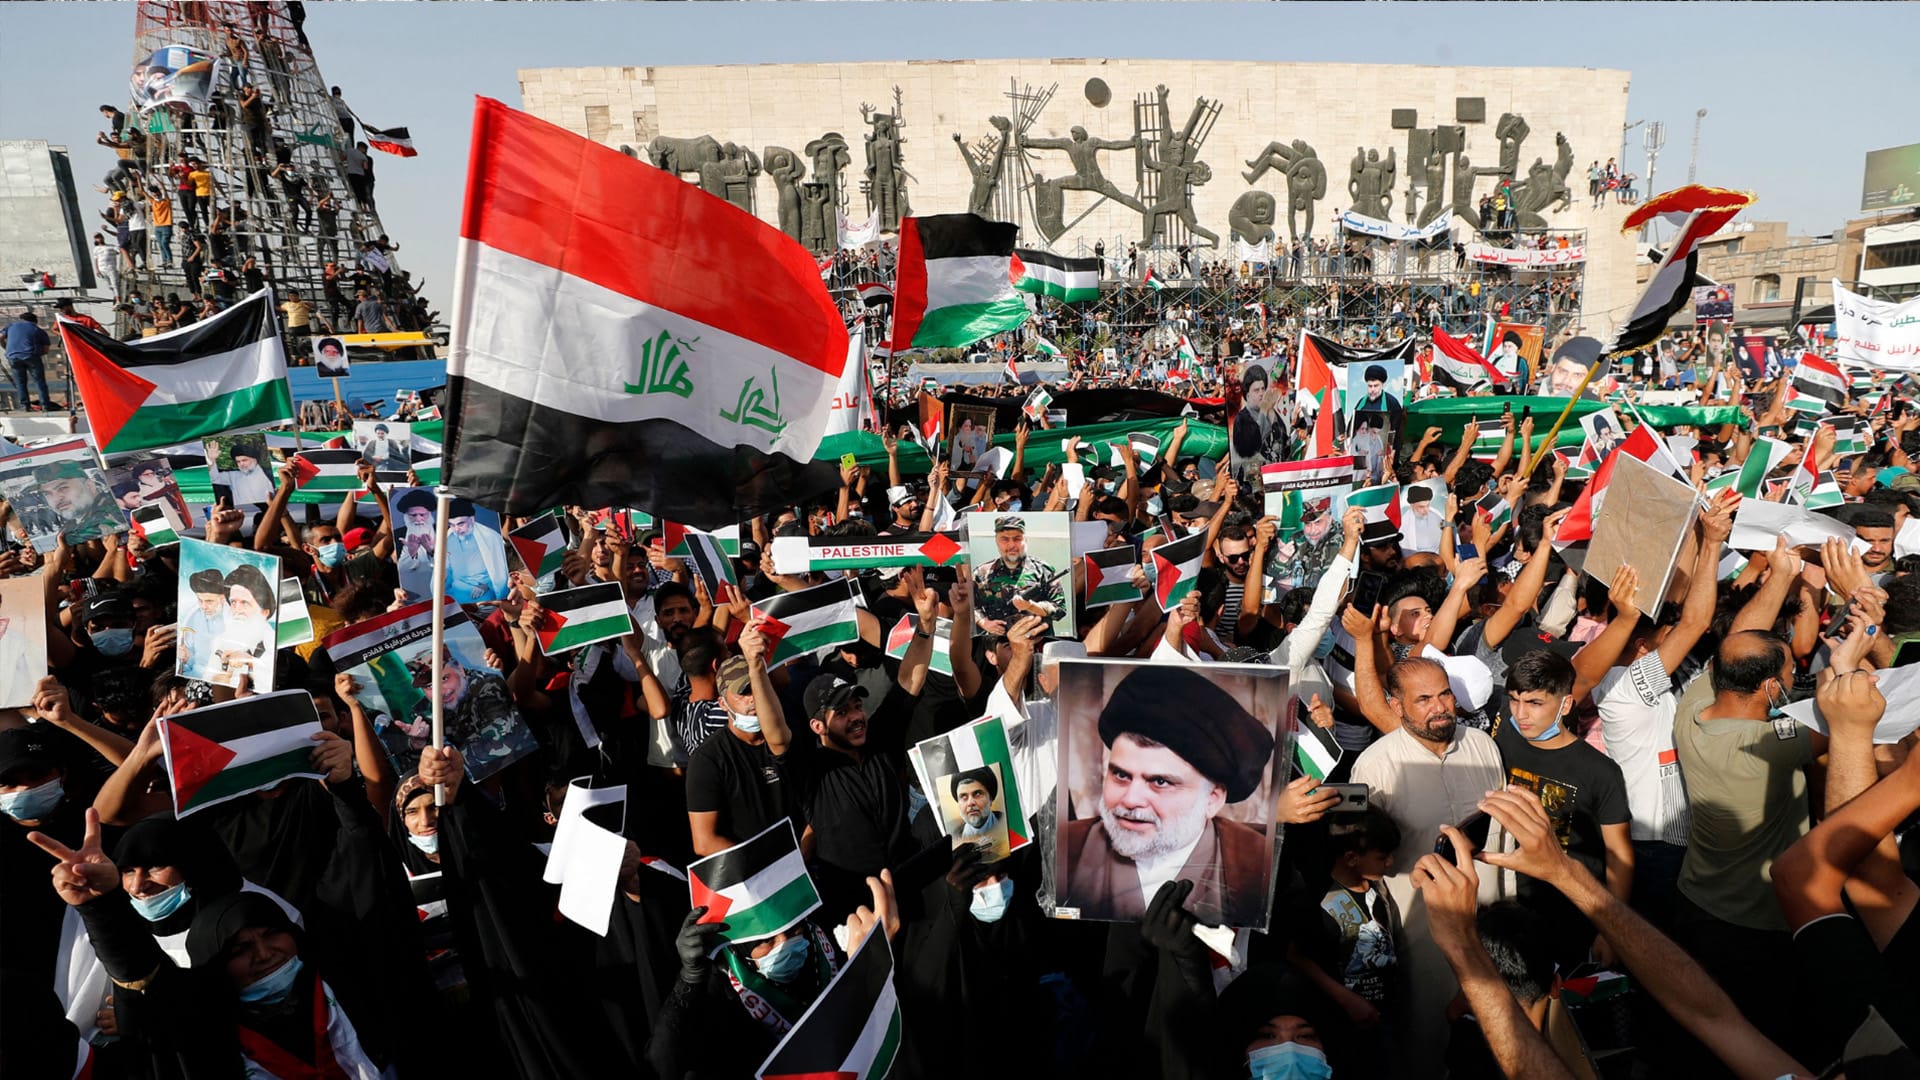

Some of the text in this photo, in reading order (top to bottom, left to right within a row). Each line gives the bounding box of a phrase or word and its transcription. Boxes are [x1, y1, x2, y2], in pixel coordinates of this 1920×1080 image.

[1538, 250, 1560, 263] كلا
[1564, 246, 1584, 261] كلا
[822, 544, 905, 558] PALESTINE
